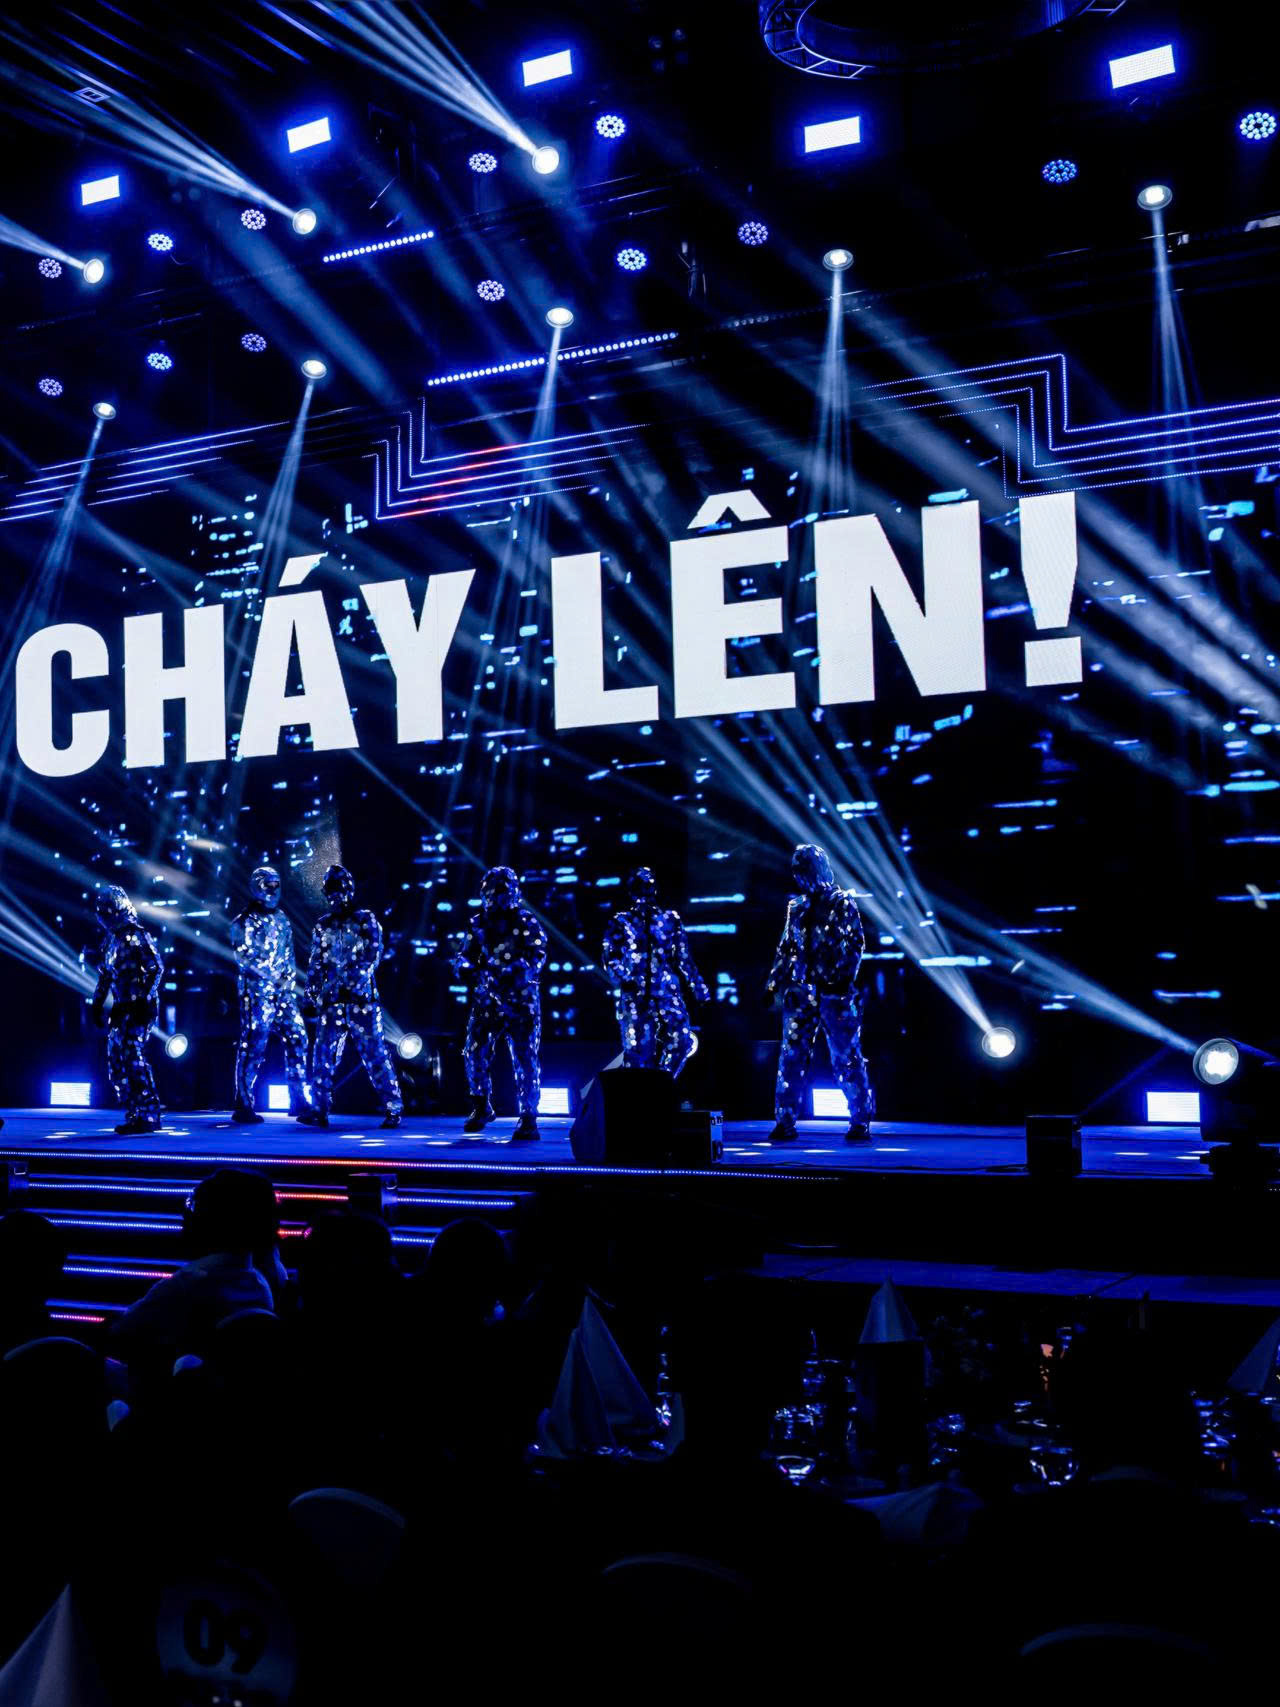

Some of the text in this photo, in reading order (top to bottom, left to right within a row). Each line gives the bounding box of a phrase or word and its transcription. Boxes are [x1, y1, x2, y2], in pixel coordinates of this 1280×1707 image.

[15, 489, 1082, 777] CHÁY LÊN!
[184, 1600, 266, 1674] 09
